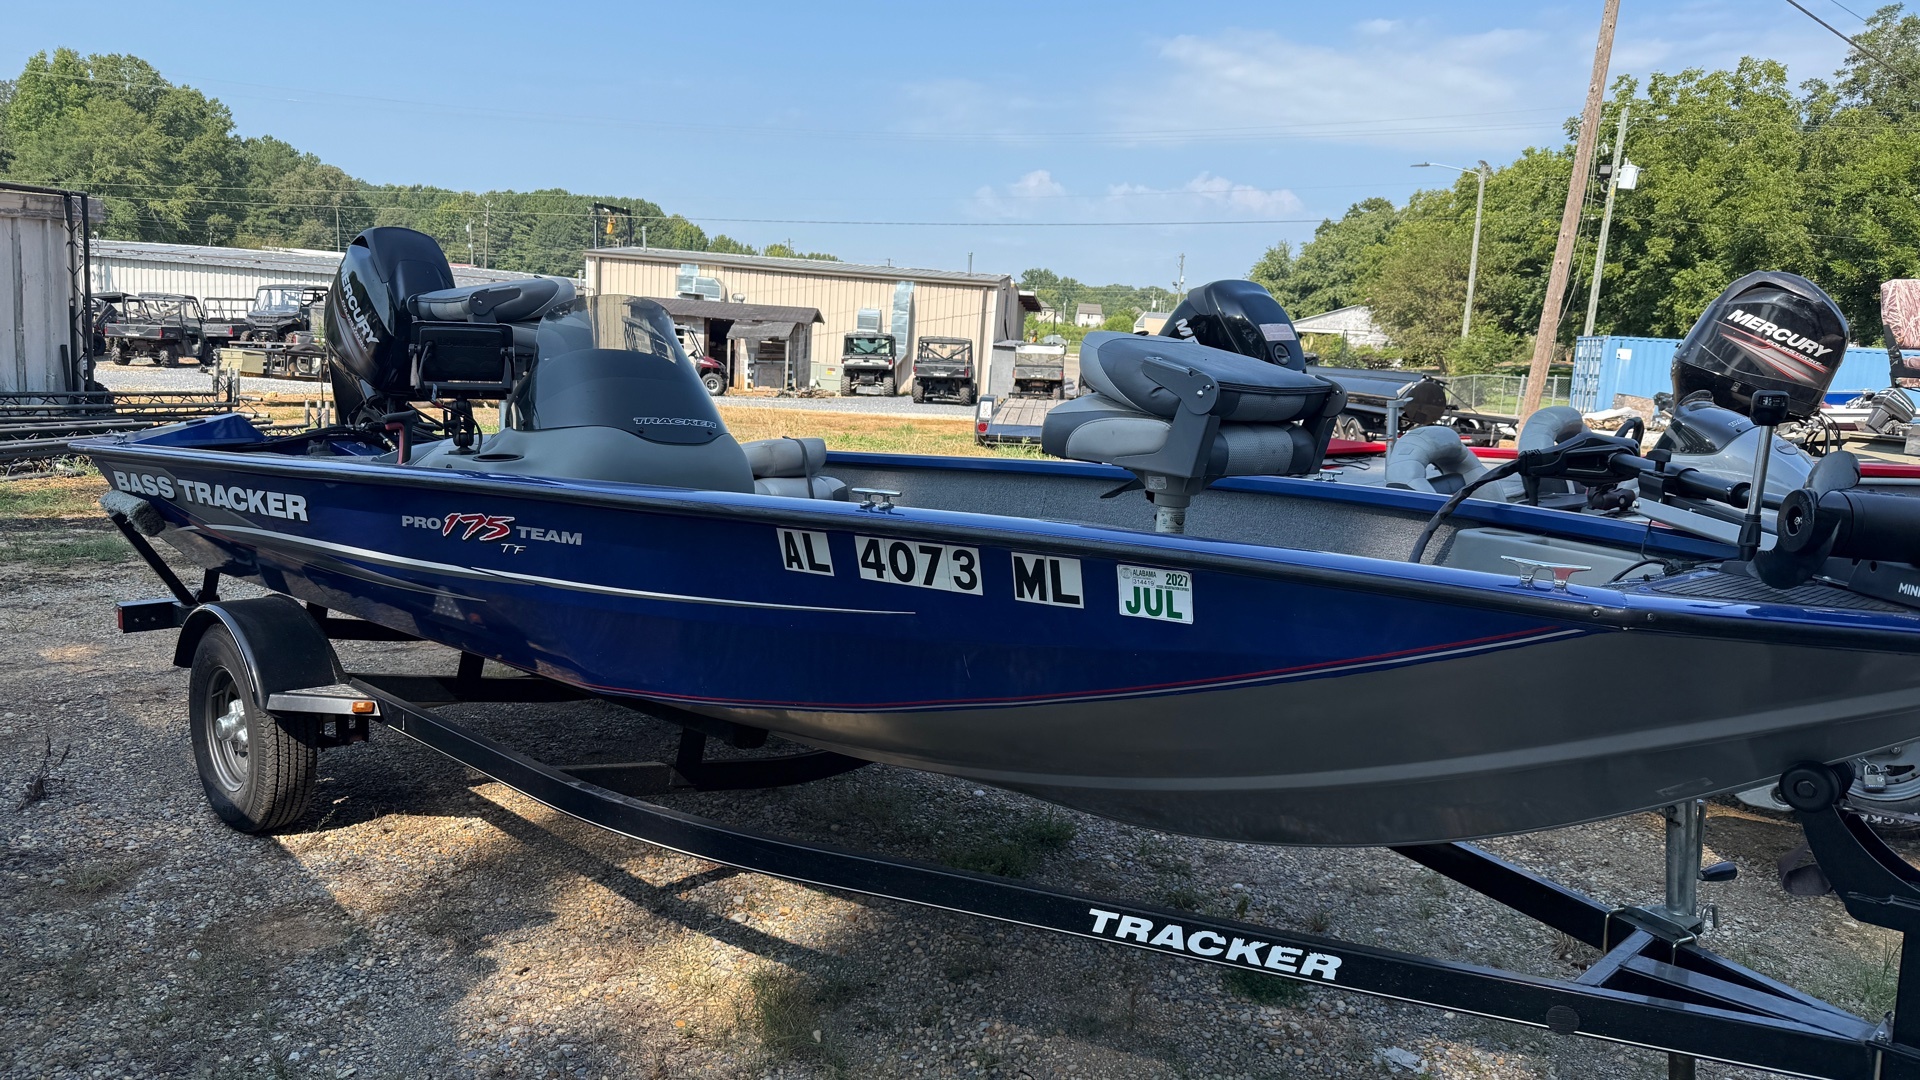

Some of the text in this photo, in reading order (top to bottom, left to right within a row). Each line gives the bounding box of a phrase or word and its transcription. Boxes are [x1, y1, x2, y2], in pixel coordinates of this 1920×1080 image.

[1726, 309, 1834, 358] MERCURY
[632, 416, 717, 429] TRACKER
[113, 470, 309, 522] BASS TRACKER
[401, 512, 583, 546] PRO 175 TEAM
[500, 543, 527, 555] TF
[783, 531, 1081, 605] AL 4073 ML
[1132, 569, 1188, 587] ALABAMA 2027
[1125, 586, 1183, 619] JUL
[1088, 907, 1343, 981] TRACKER
